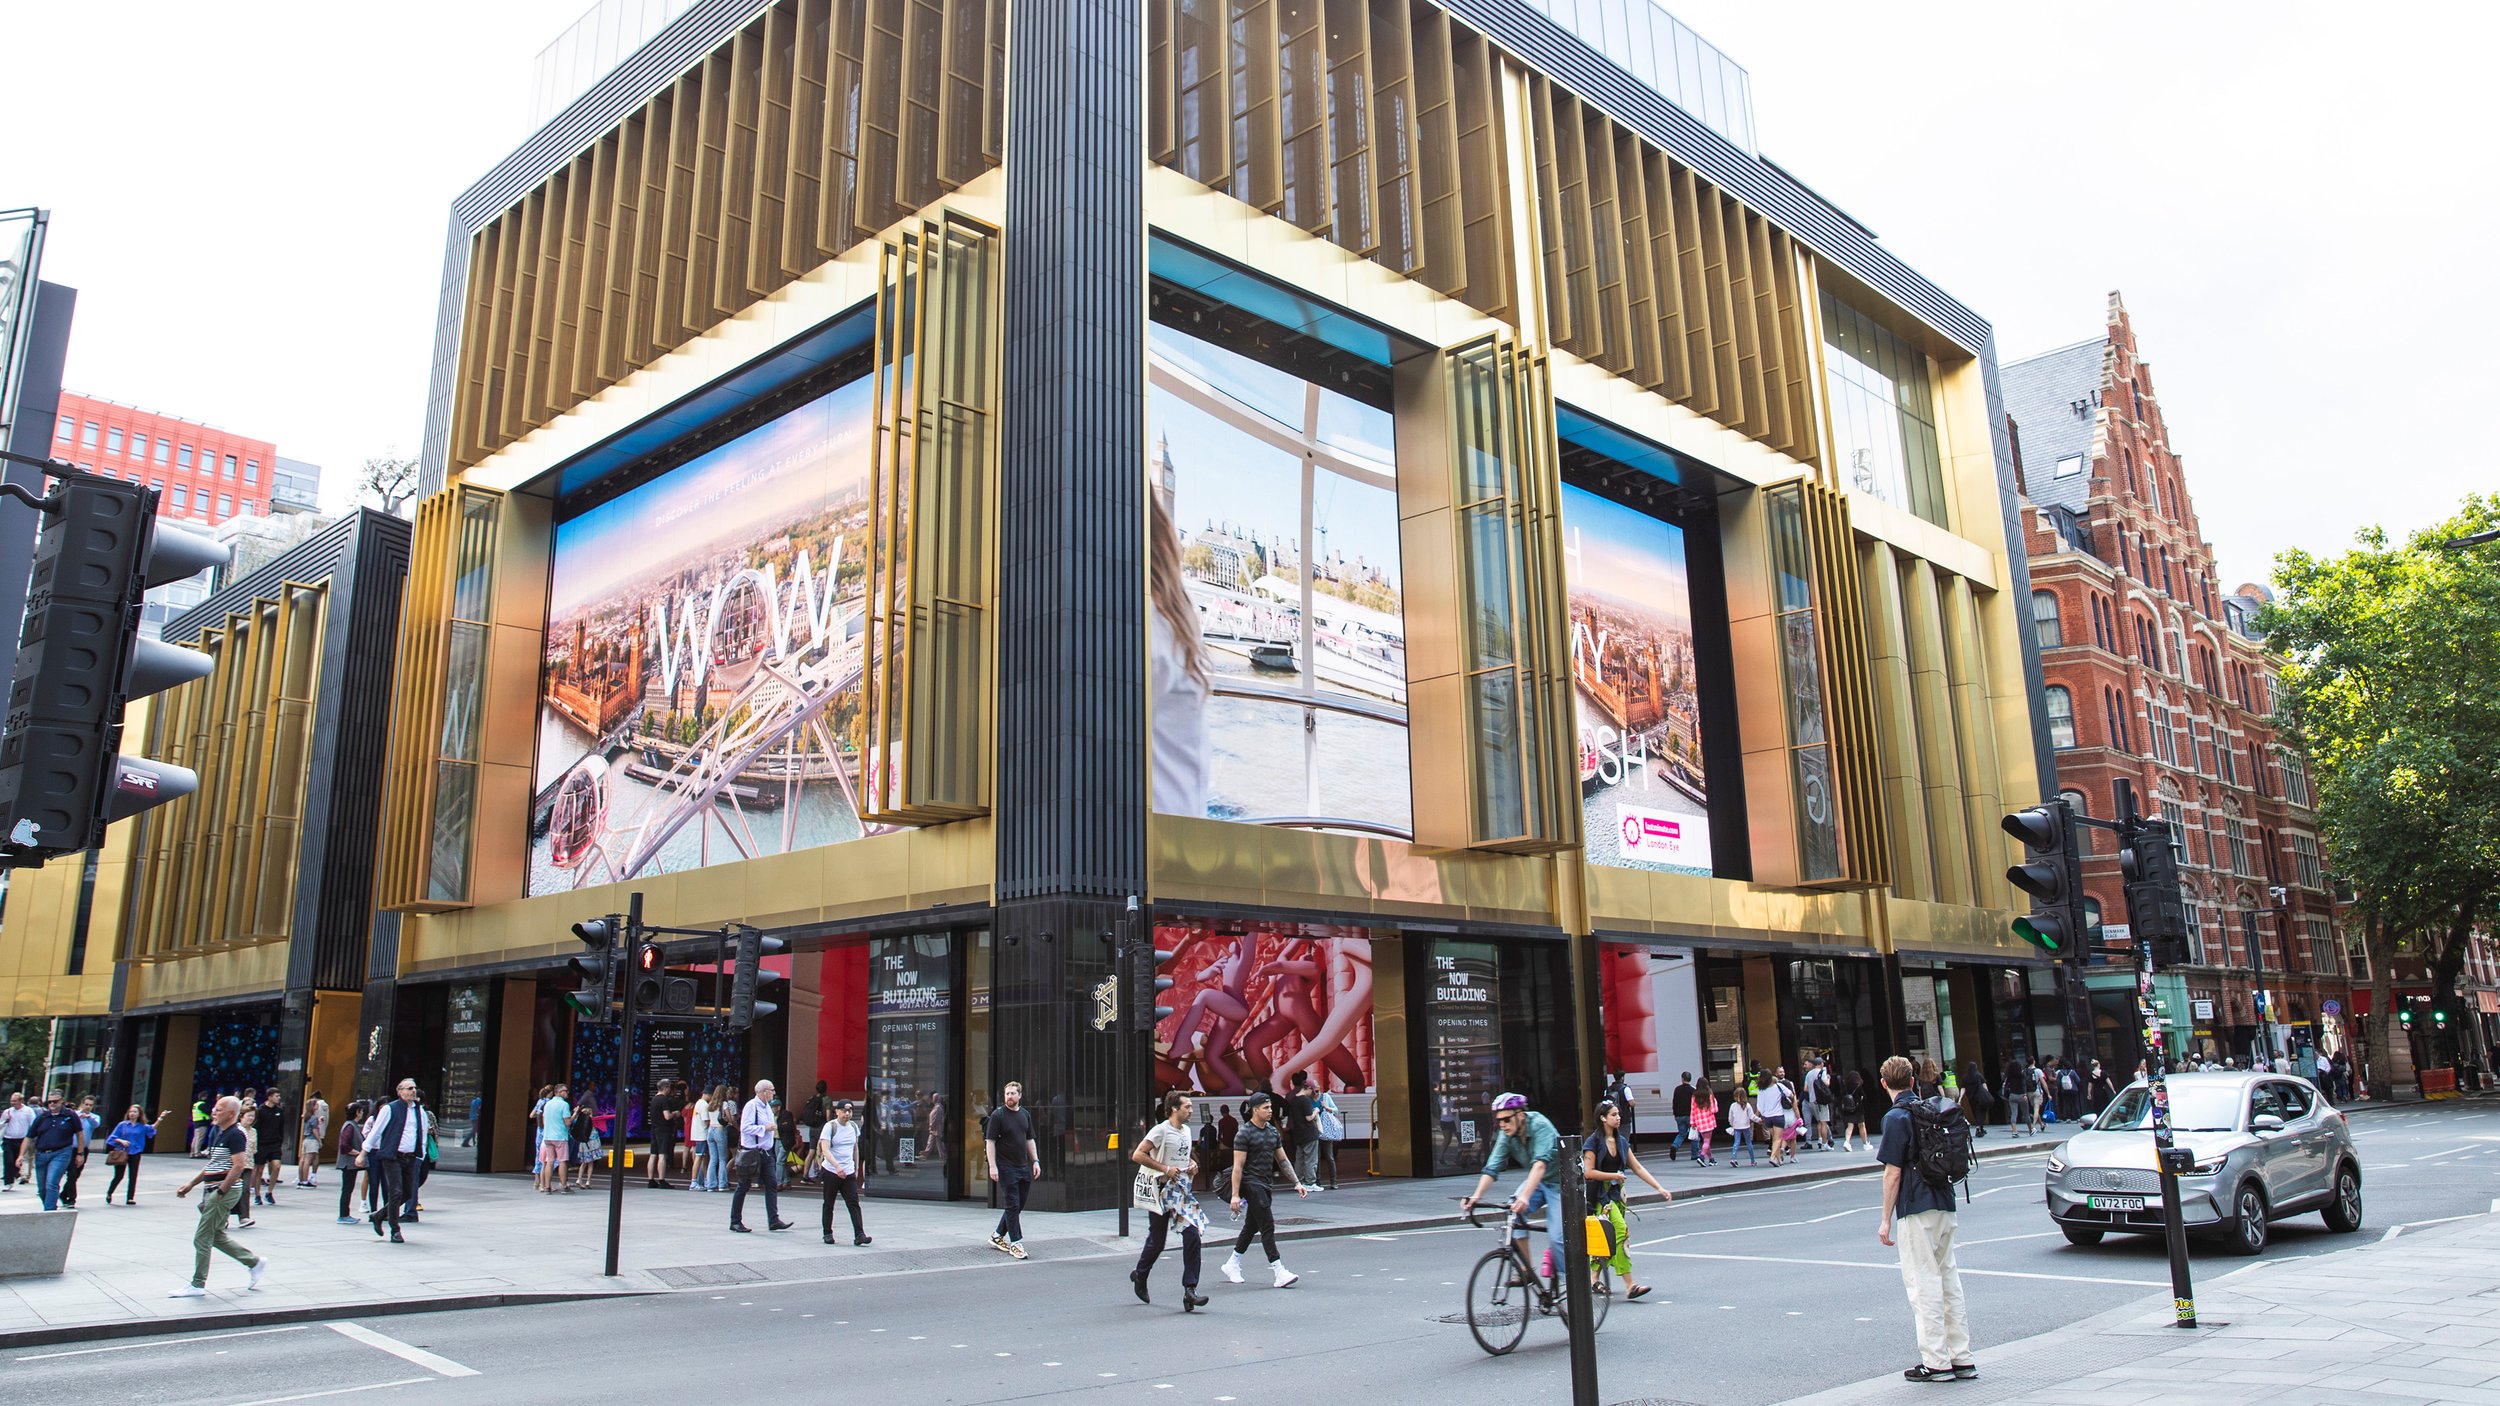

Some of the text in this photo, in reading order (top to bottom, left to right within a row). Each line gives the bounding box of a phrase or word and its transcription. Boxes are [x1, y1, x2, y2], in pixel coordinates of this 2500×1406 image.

[655, 430, 852, 528] DISCOVER THE FEELING AT EVERY TURN
[658, 534, 844, 697] WOW
[1646, 838, 1679, 853] London Eye
[883, 955, 904, 970] THE
[1436, 956, 1455, 970] THE
[896, 971, 918, 986] NOW
[1448, 972, 1469, 986] NOW
[882, 986, 937, 1005] BUILDING
[1436, 987, 1487, 1002] BUILDING
[455, 998, 466, 1009] THE
[461, 1010, 473, 1020] NOW
[453, 1021, 481, 1033] BUILDING
[882, 1022, 937, 1033] OPENING TIMES
[1437, 1019, 1488, 1027] OPENING TIMES
[2094, 1198, 2142, 1209] OV72 FOC
